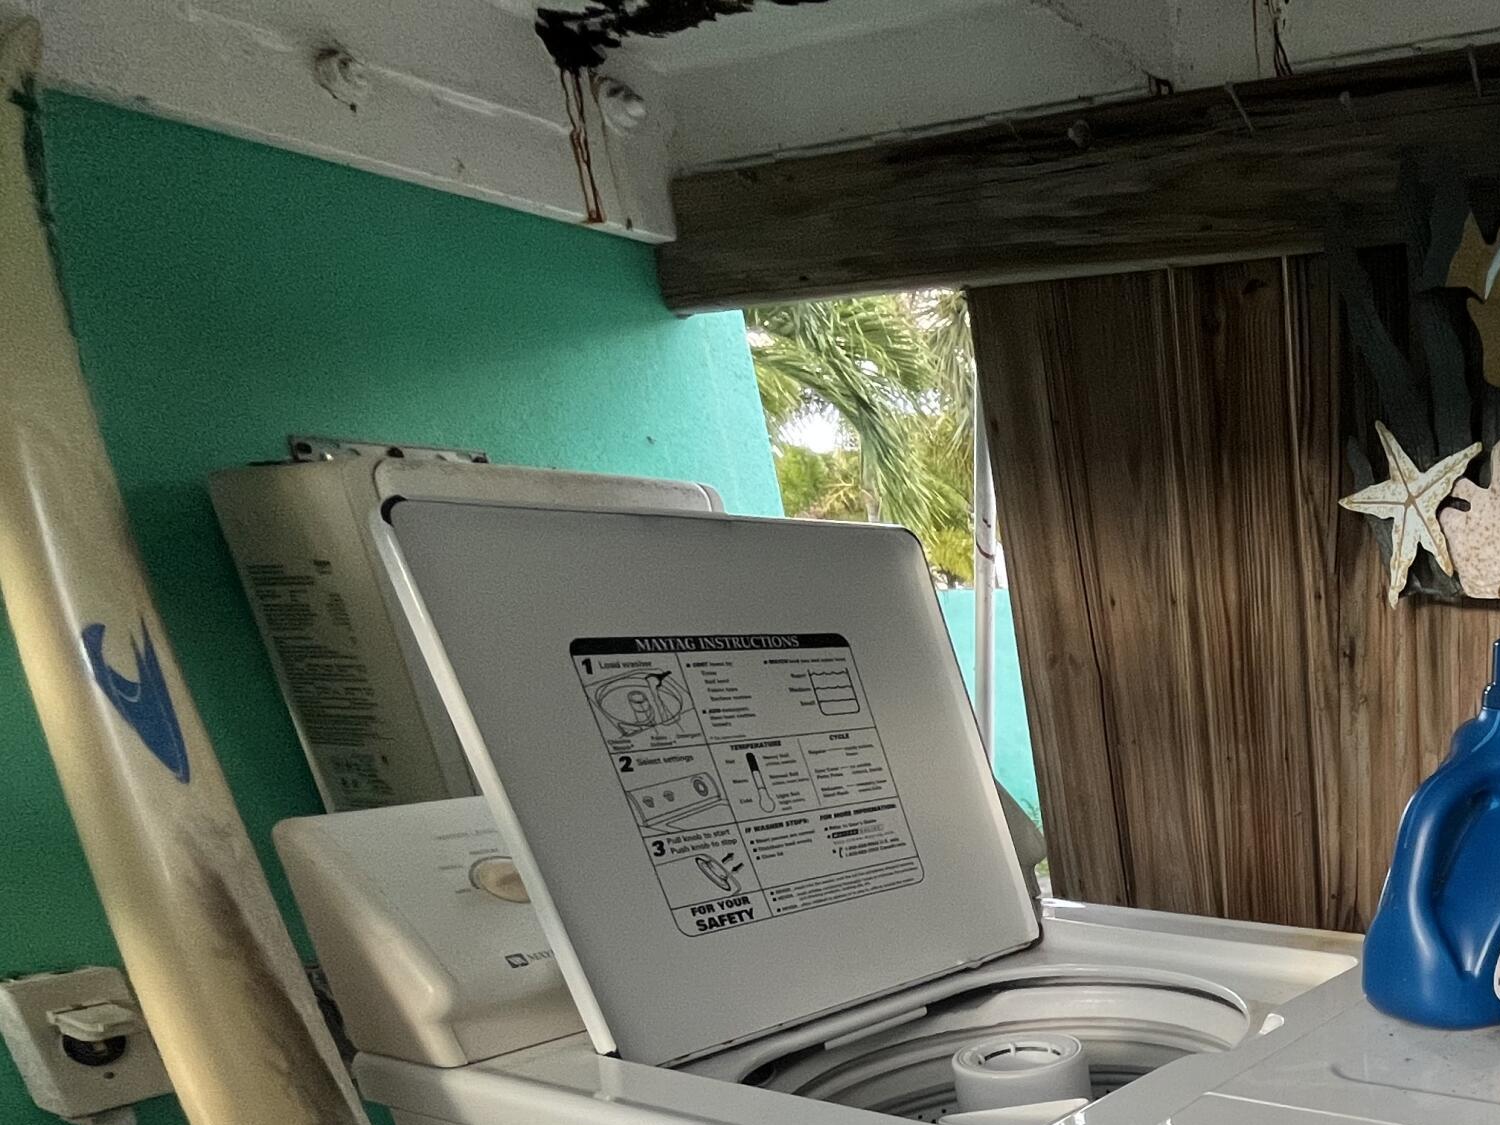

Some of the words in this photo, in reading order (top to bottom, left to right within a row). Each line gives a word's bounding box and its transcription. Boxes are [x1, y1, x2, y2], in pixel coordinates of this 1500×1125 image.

[635, 638, 697, 651] MAYTAG
[699, 636, 799, 650] INSTRUCTIONS
[582, 658, 593, 675] 1
[618, 756, 634, 772] 2
[636, 757, 662, 766] Select
[663, 755, 694, 765] settings
[754, 822, 784, 832] WASHER
[666, 836, 682, 845] Pull
[682, 834, 703, 842] knob
[713, 829, 731, 837] start
[652, 840, 666, 857] 3
[670, 846, 690, 855] Push
[691, 843, 711, 851] knob
[690, 904, 716, 917] FOR
[717, 896, 751, 911] YOUR
[696, 908, 755, 931] SAFETY
